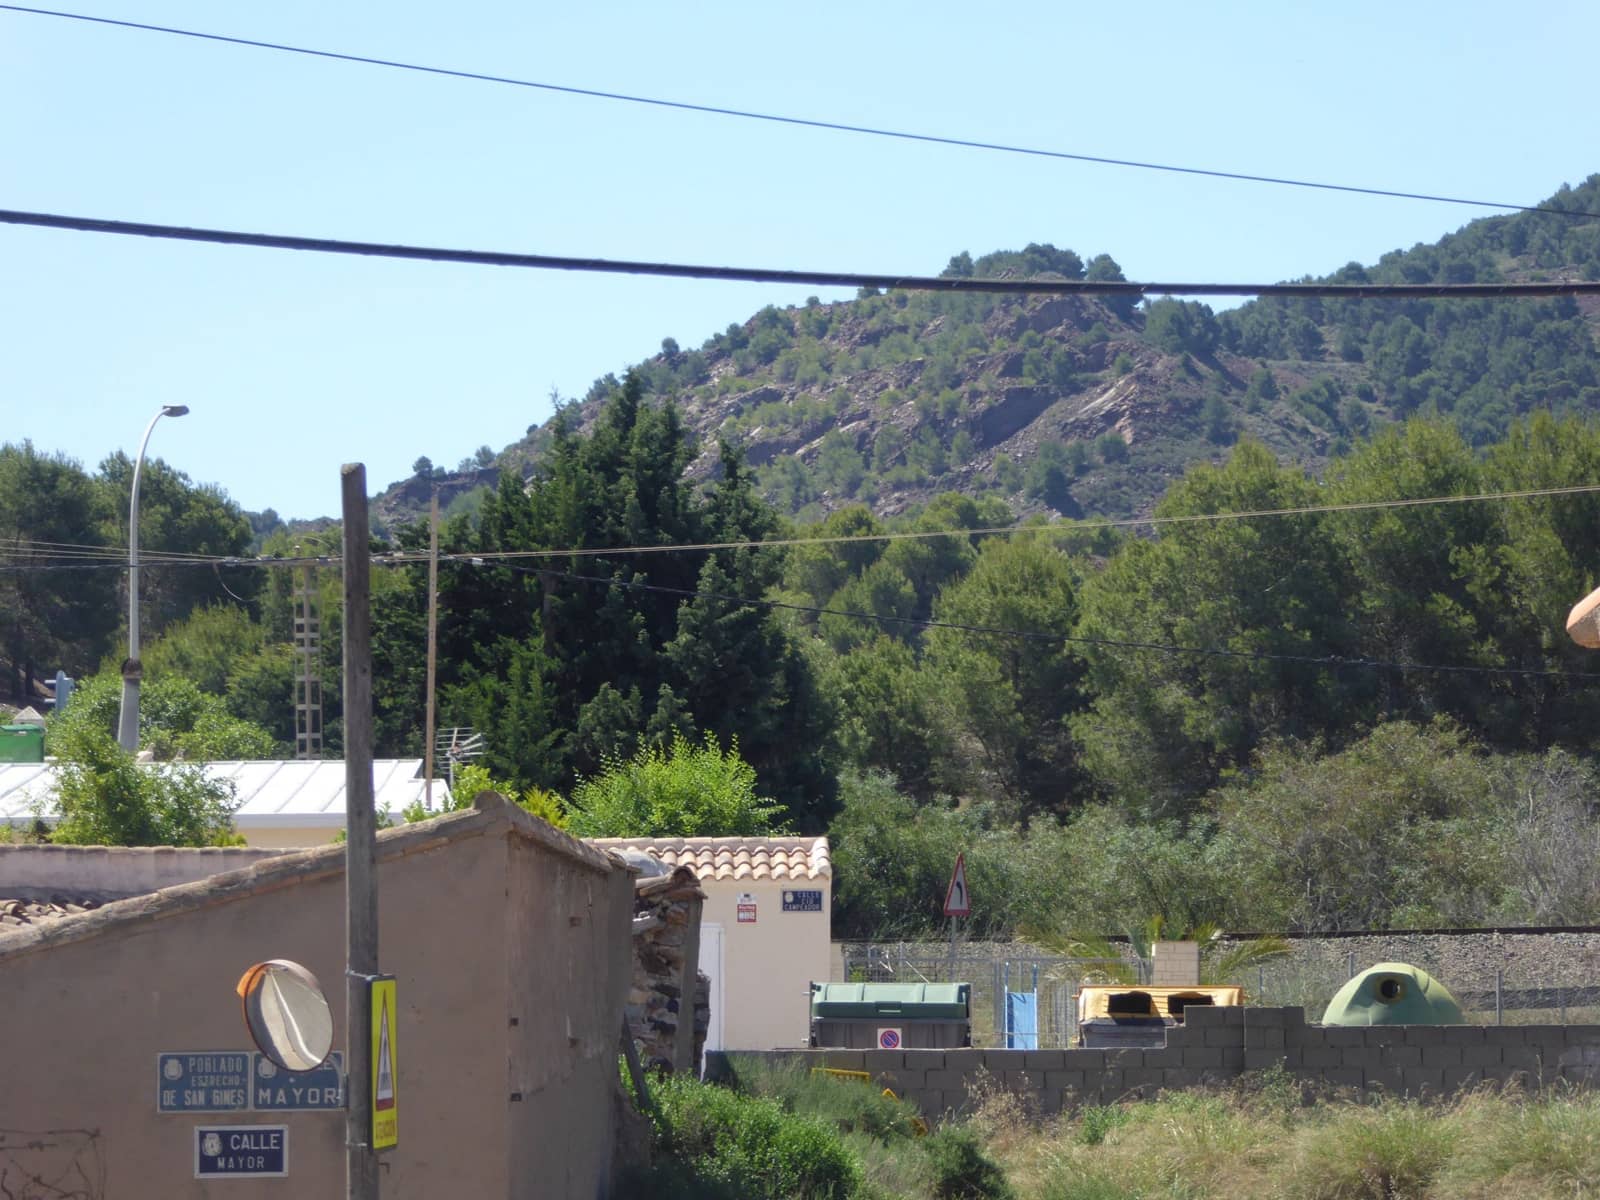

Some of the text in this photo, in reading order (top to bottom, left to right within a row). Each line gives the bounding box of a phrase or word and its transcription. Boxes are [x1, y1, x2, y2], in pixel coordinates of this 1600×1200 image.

[188, 1056, 243, 1073] POBLADO
[162, 1088, 245, 1106] DE SAN GINES
[258, 1087, 337, 1105] MAYOR
[230, 1133, 281, 1151] CALLE
[217, 1156, 265, 1169] MAYOR
